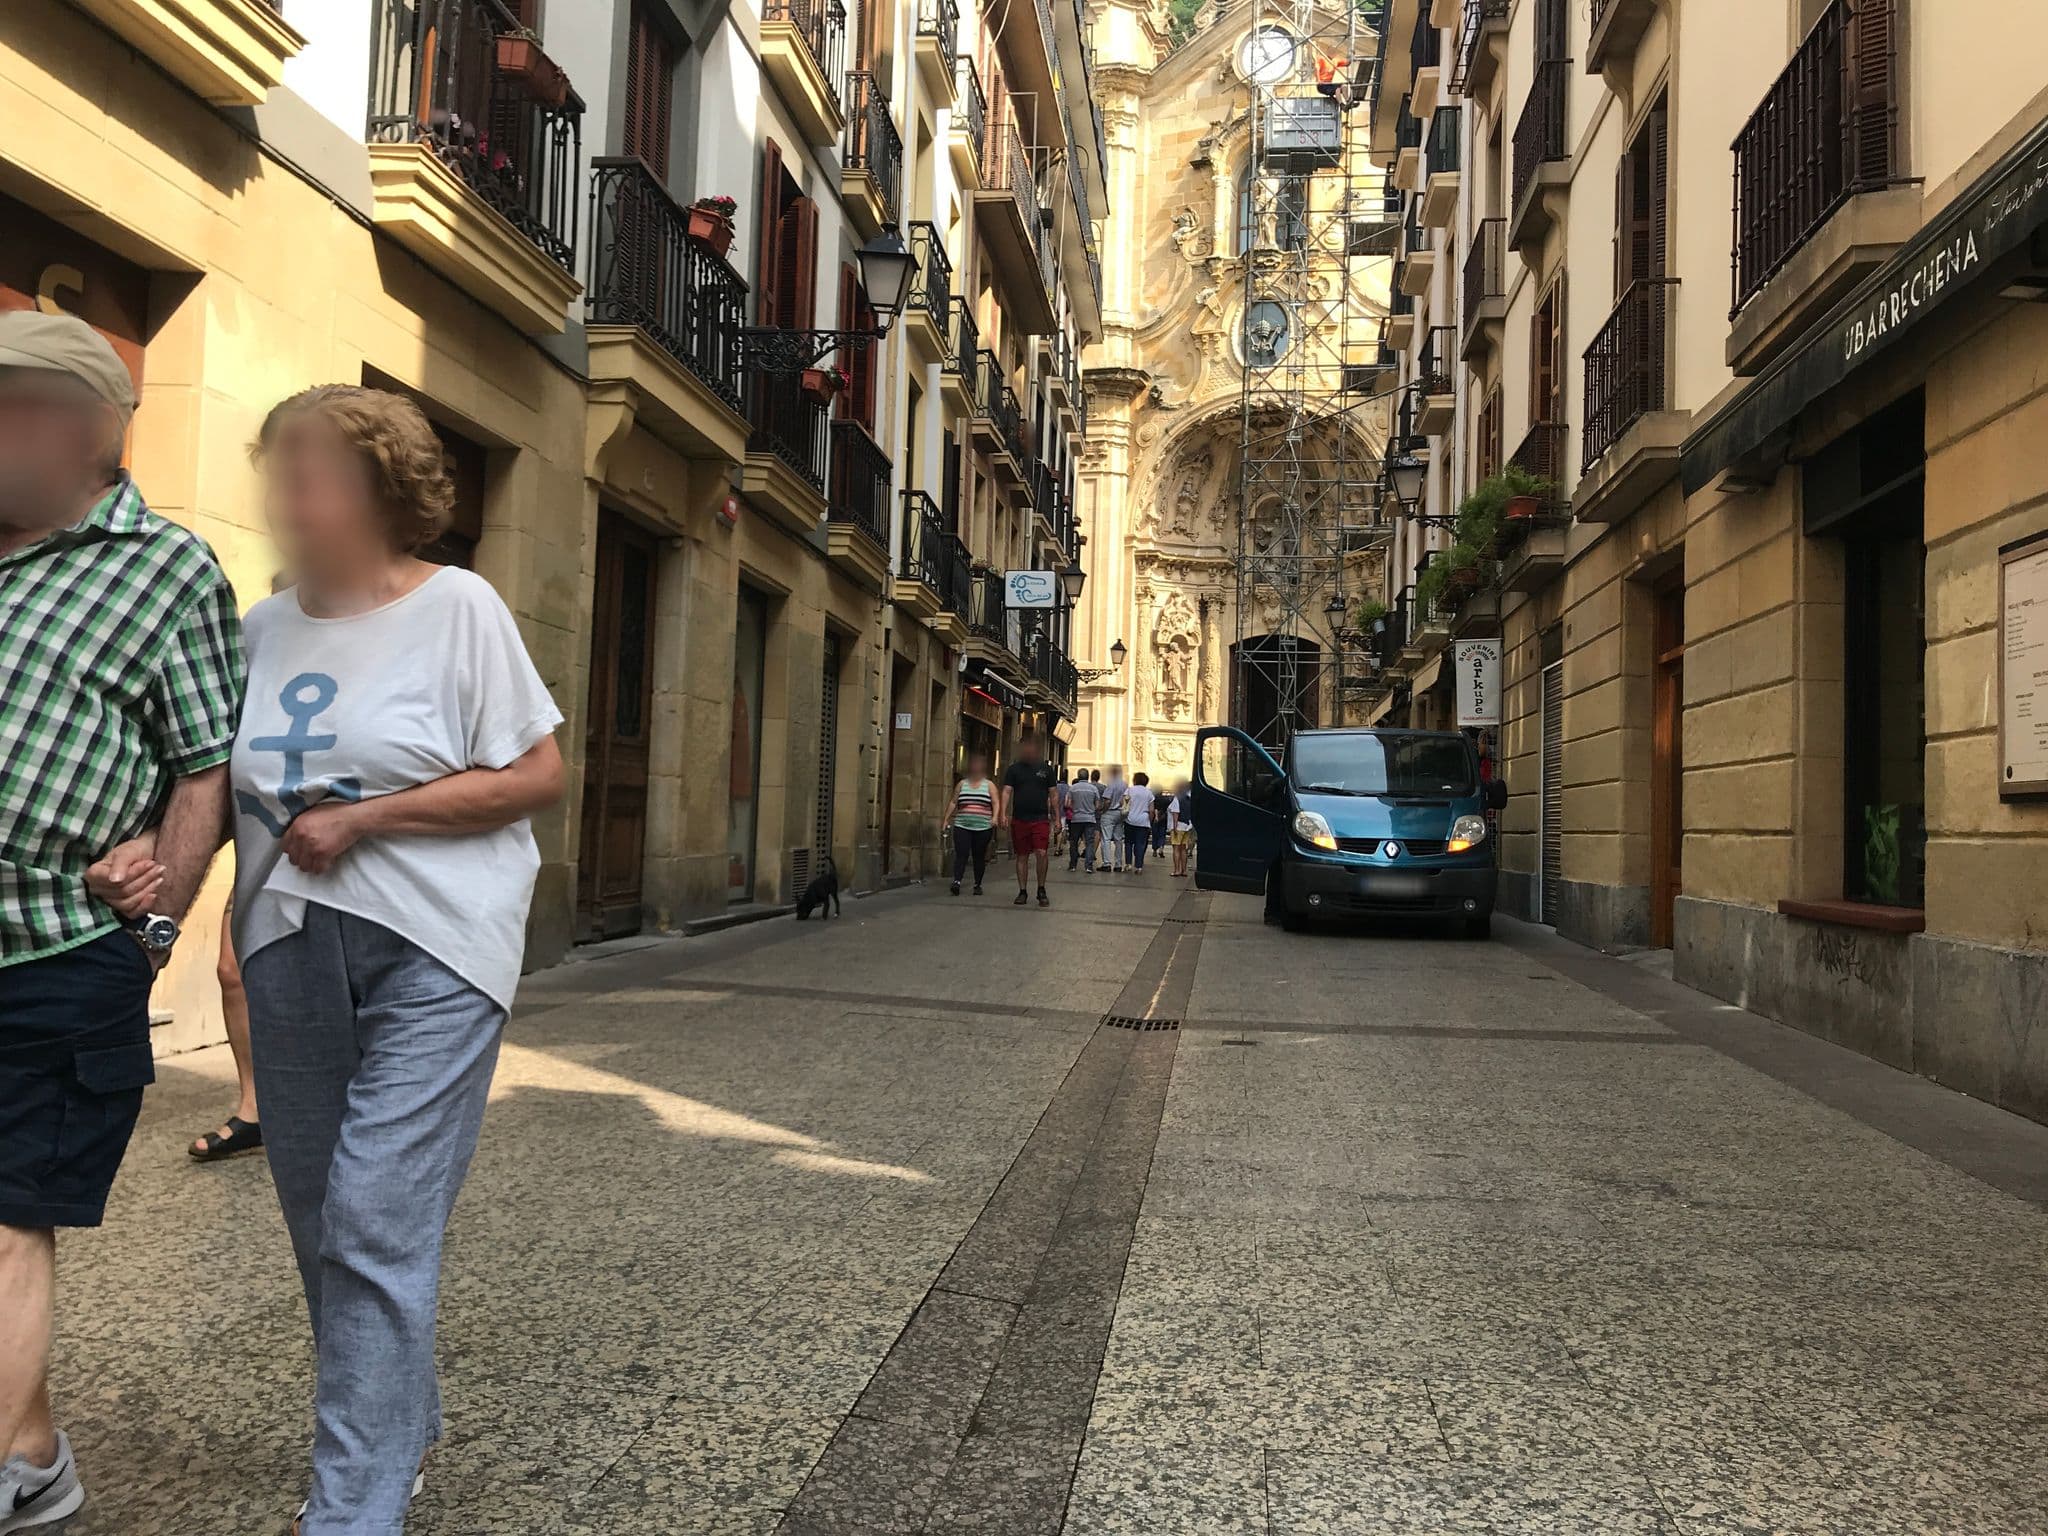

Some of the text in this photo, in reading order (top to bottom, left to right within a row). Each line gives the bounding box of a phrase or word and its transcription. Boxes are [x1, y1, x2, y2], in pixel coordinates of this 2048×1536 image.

[1844, 229, 1978, 360] UBARRECHENA
[1459, 644, 1497, 661] SOUVENIRS
[1473, 658, 1484, 714] arkupe
